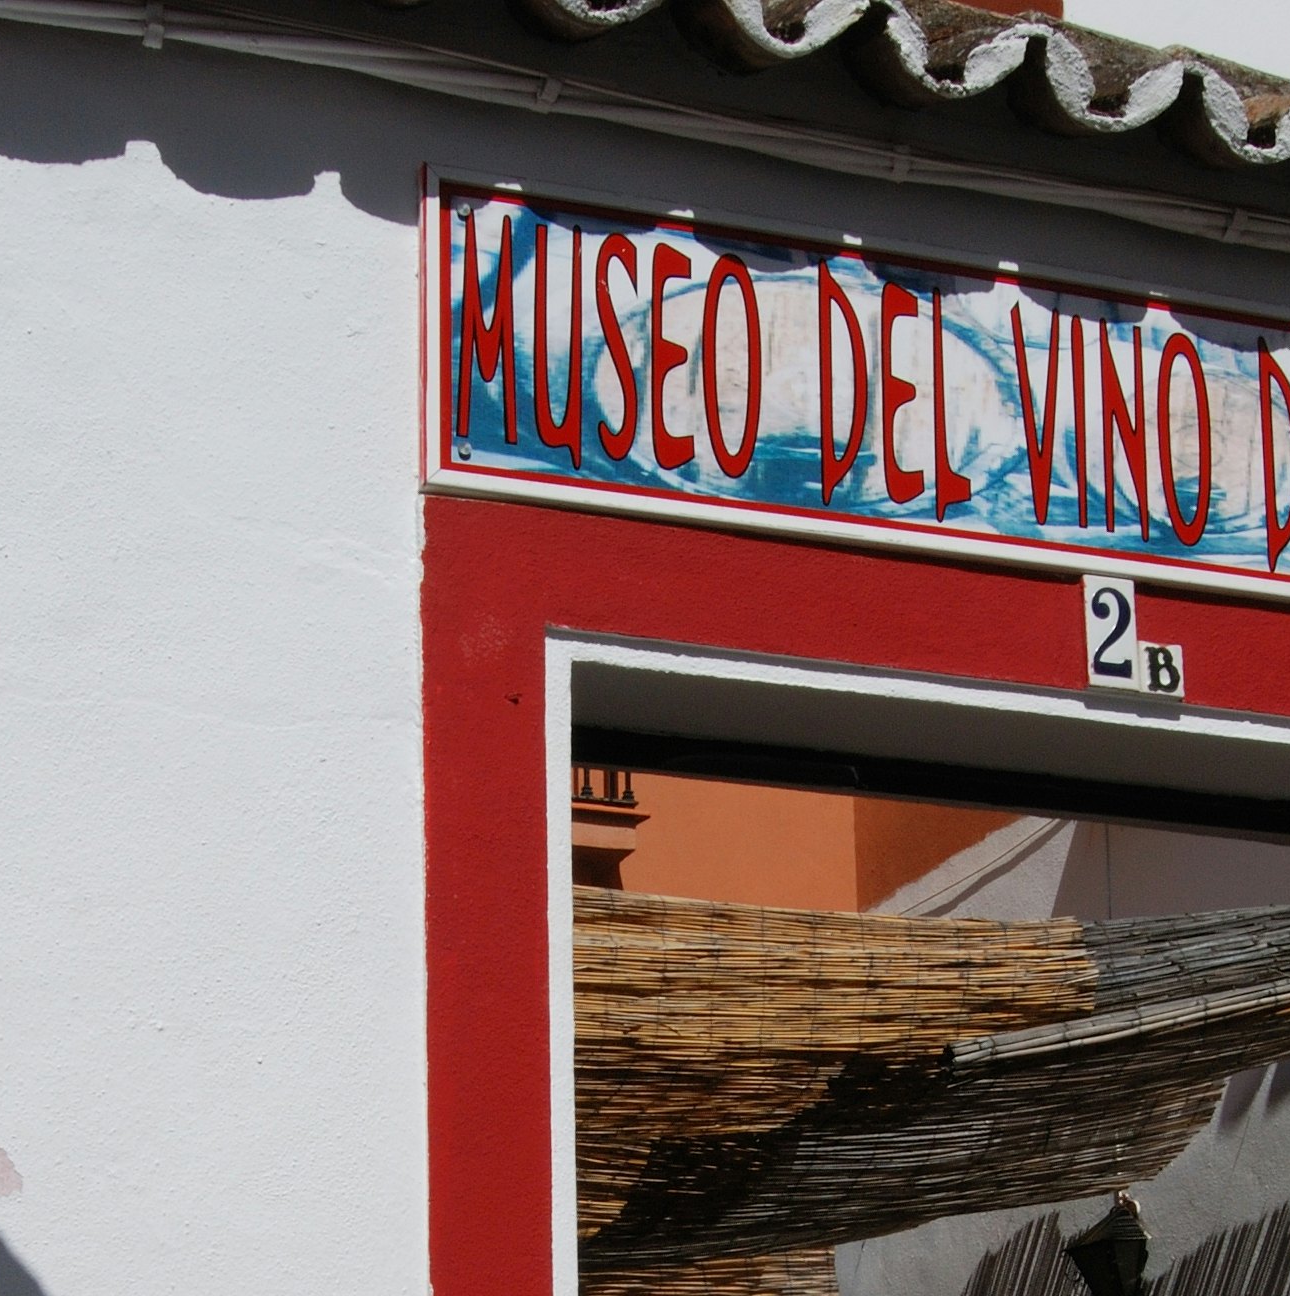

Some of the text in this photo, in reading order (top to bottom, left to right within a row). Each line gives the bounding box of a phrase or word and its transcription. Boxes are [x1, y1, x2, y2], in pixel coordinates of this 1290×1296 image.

[457, 212, 761, 481] MUSEO
[819, 255, 972, 521] DEL
[1010, 300, 1215, 548] VINO
